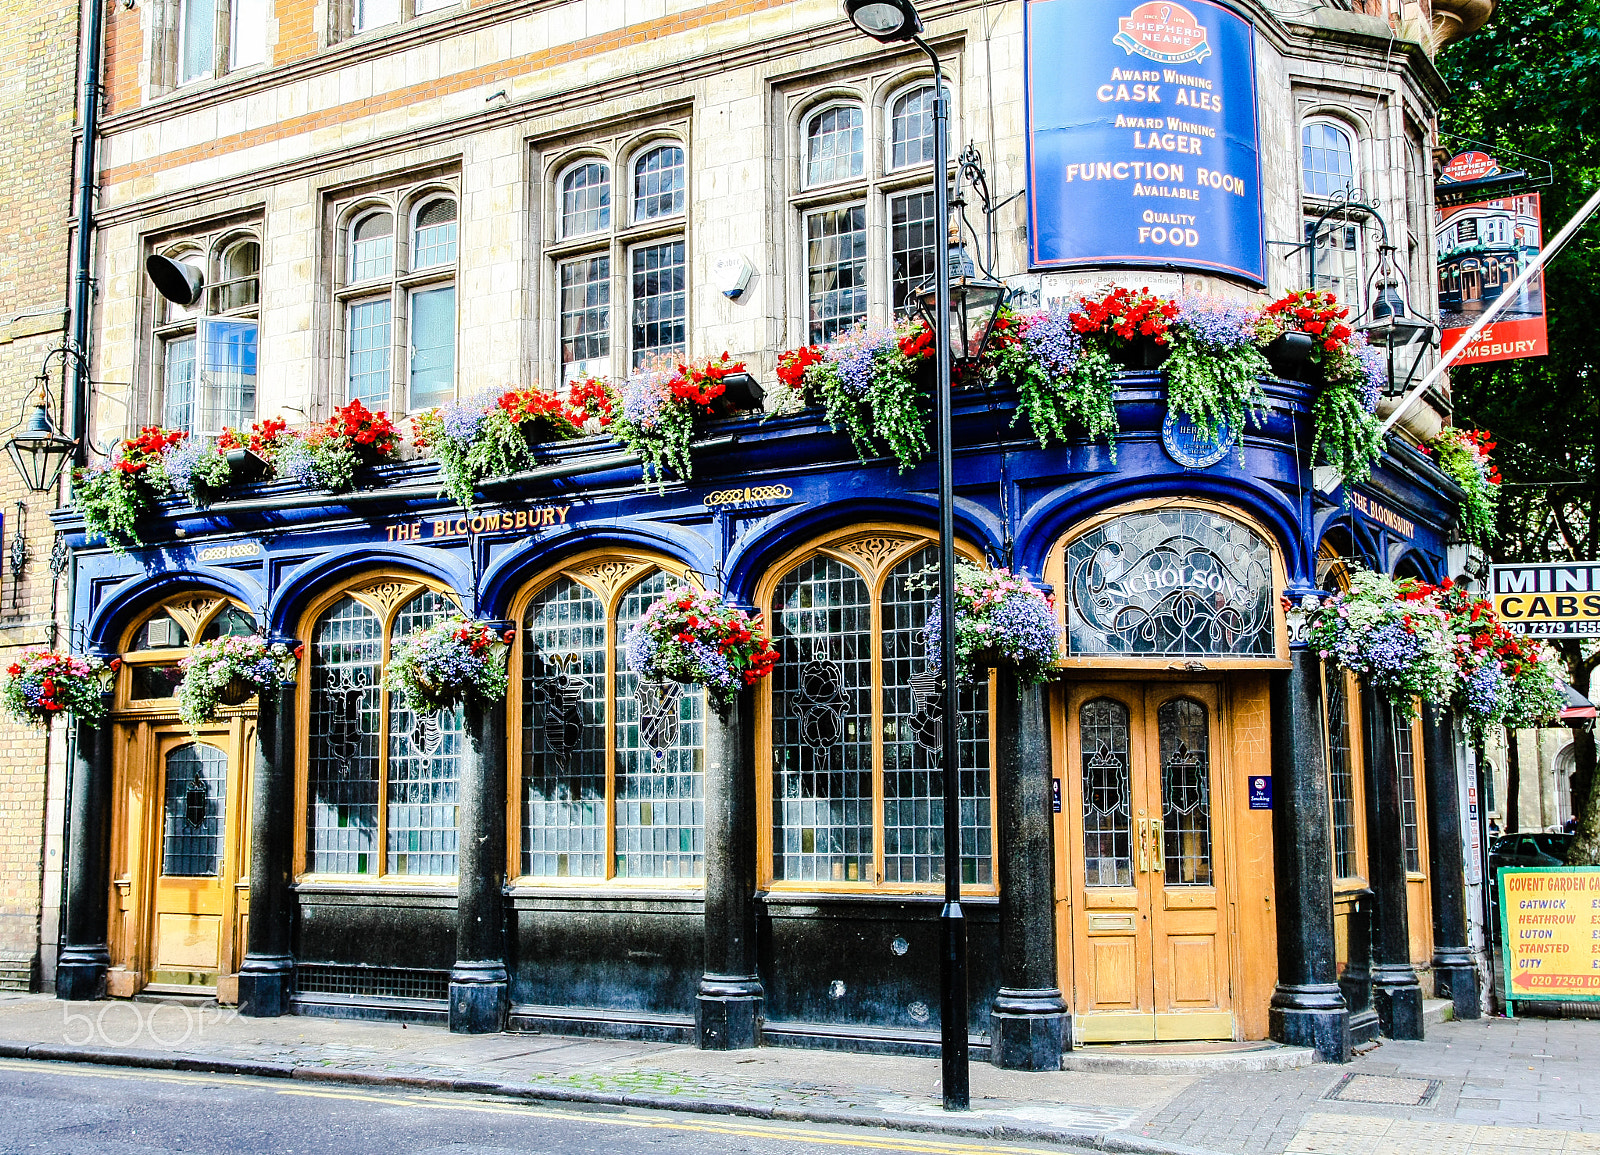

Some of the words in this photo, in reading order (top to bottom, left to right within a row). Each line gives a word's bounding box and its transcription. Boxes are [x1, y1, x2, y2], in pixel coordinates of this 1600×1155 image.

[1125, 21, 1202, 38] SHEPHERD
[1142, 33, 1191, 46] NEAME
[1133, 43, 1163, 60] MASTER
[1110, 67, 1160, 82] AWARD
[1163, 69, 1213, 90] WINNING
[1096, 84, 1161, 103] CASK
[1175, 90, 1222, 113] ALES
[1114, 114, 1164, 129] AWARD
[1166, 117, 1217, 139] WINNING
[1133, 131, 1203, 156] LAGER
[1445, 160, 1494, 173] SHEPHERD
[1454, 167, 1485, 178] NEAME
[1065, 161, 1185, 183] FUNCTION
[1196, 167, 1245, 197] ROOM
[1133, 183, 1200, 201] AVAILABLE
[1142, 209, 1196, 226] QUALITY
[1137, 226, 1200, 247] FOOD
[1065, 277, 1092, 285] London
[1097, 276, 1129, 285] Borough
[1147, 276, 1178, 285] Camden
[385, 522, 421, 542] THE
[432, 505, 571, 537] BLOOMSBURY
[1352, 491, 1368, 512] THE
[1370, 500, 1415, 539] BLOOMSBURY
[1500, 595, 1600, 618] CABS
[1529, 622, 1566, 634] 7379
[1509, 877, 1545, 892] COVENT
[1548, 877, 1586, 892] GARDEN
[1519, 899, 1567, 909] GATWICK
[1518, 914, 1576, 924] HEATHROW
[1519, 929, 1553, 939] LUTON
[1518, 943, 1570, 953] STANSTED
[1519, 959, 1542, 968] CITY
[1531, 976, 1552, 986] 020
[1555, 976, 1583, 986] 7240
